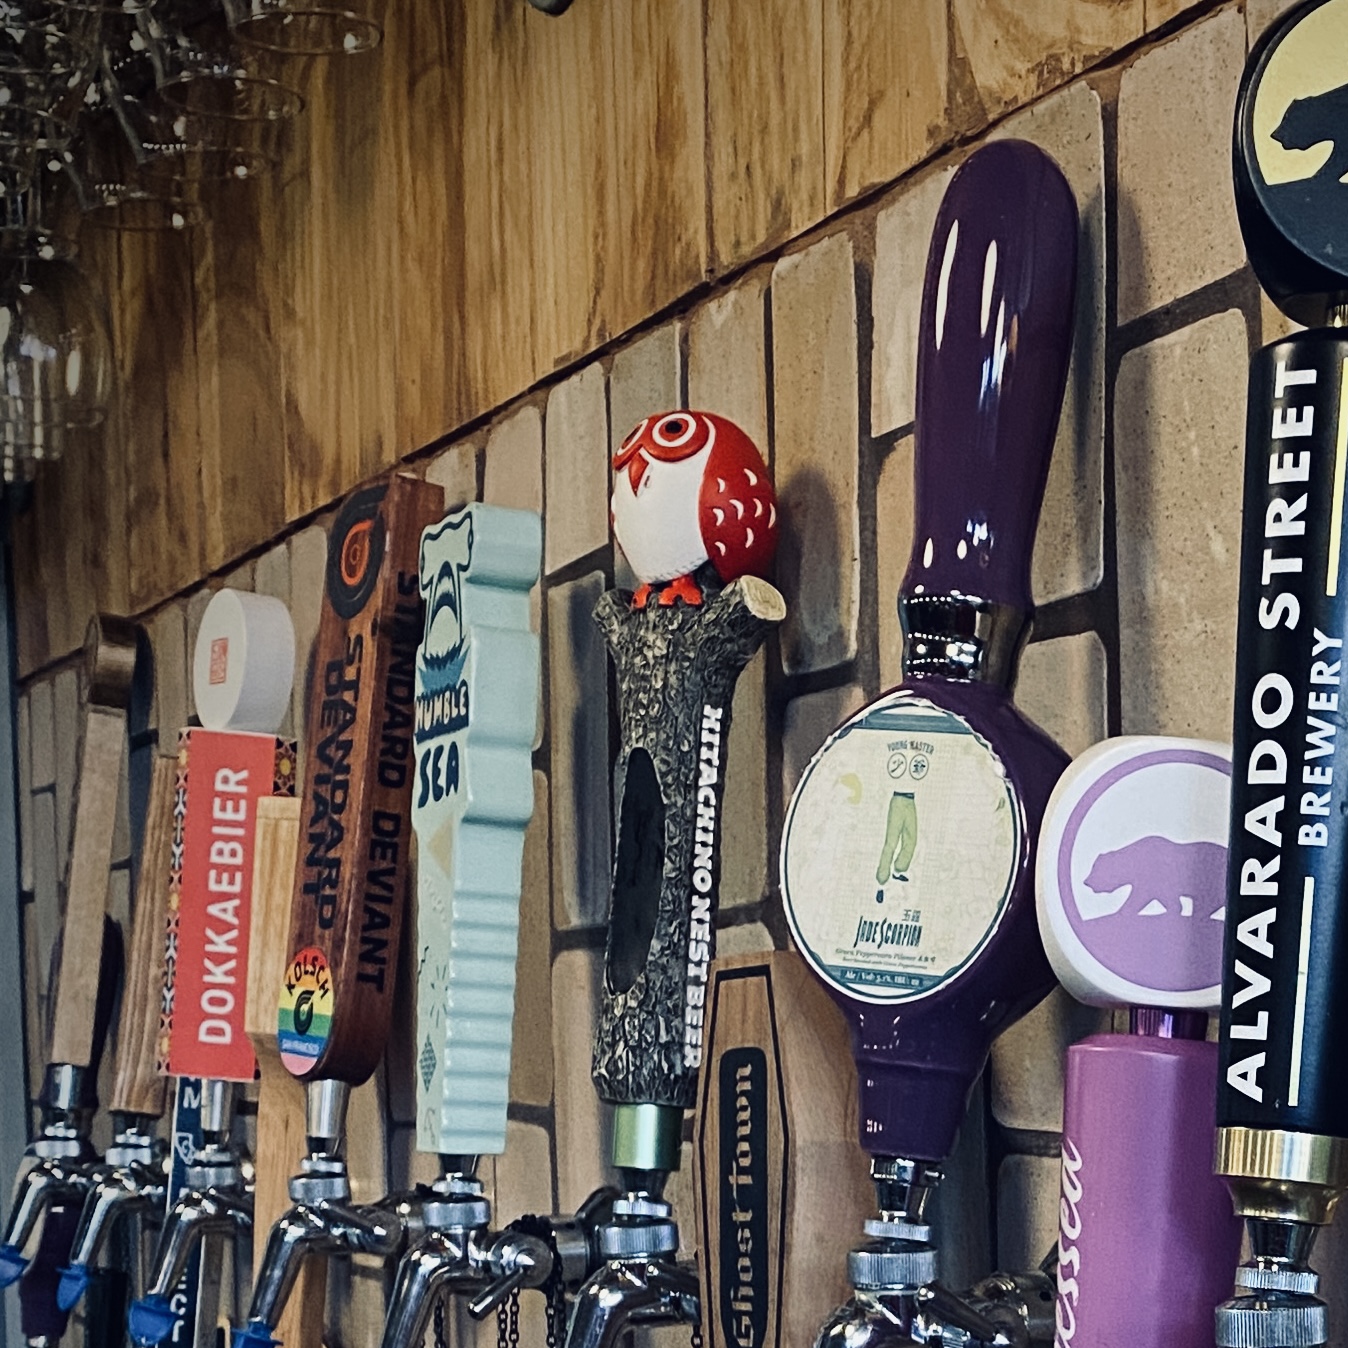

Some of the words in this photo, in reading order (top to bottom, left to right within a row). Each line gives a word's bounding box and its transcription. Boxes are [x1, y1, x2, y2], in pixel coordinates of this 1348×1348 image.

[1259, 361, 1318, 631] STREET
[302, 659, 345, 896] DEVIANT
[318, 633, 364, 930] STANDARD
[415, 685, 468, 733] HUMBLE
[417, 741, 460, 809] SEA
[1298, 627, 1344, 848] BREWERY
[198, 767, 249, 1045] DOKKAEBIER
[357, 809, 401, 992] DEVIANT
[687, 895, 711, 982] NEST
[1227, 672, 1295, 1105] ALVARADO
[683, 985, 705, 1070] BEER
[730, 1203, 754, 1348] Ghost
